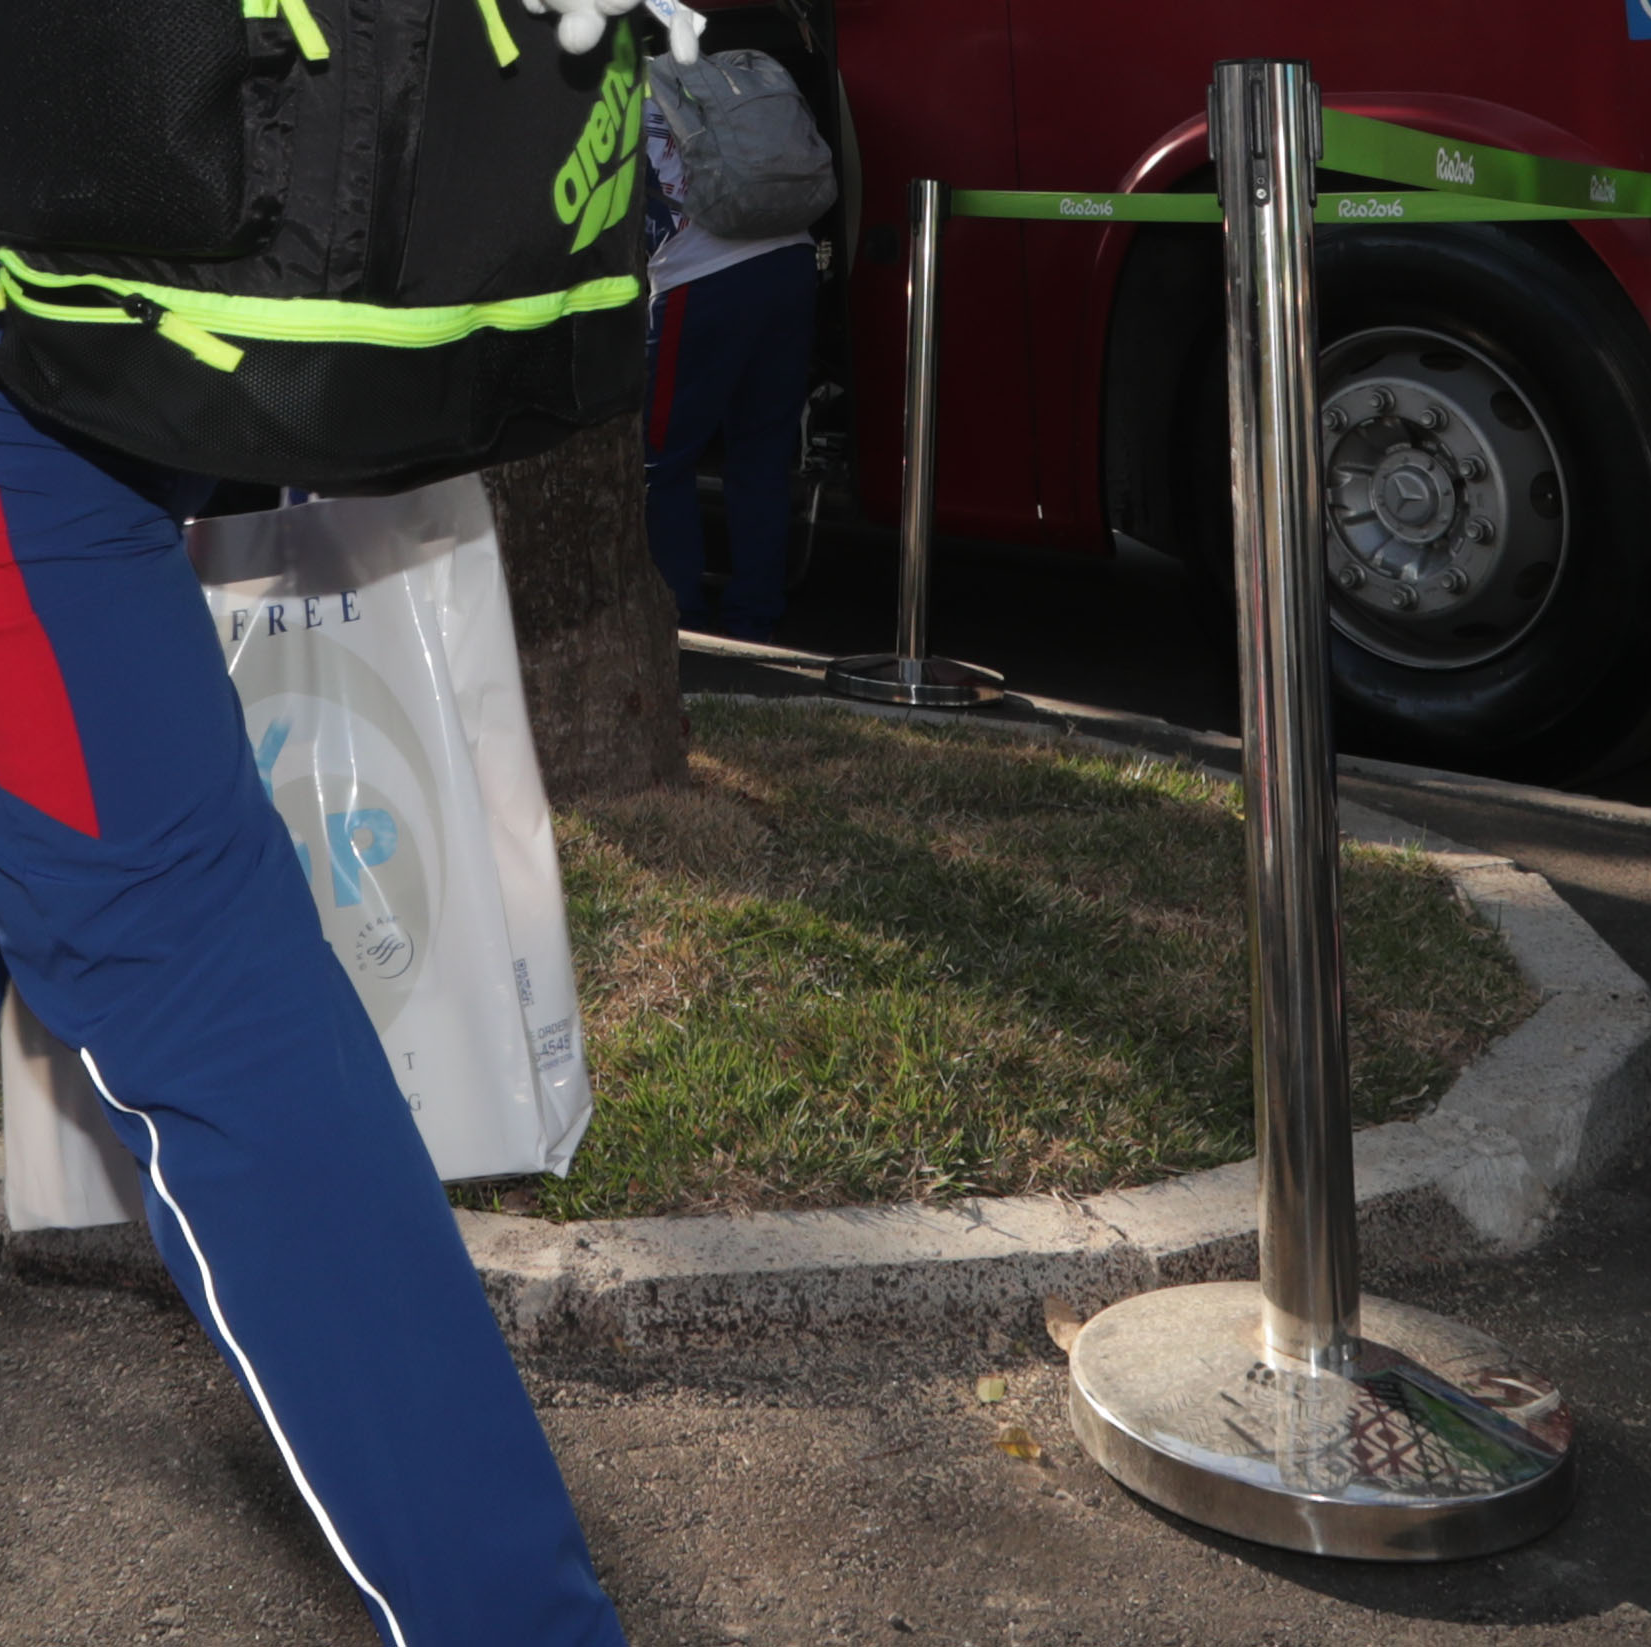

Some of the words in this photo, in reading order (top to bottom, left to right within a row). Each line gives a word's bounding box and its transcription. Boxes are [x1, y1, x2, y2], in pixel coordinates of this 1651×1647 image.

[1436, 147, 1475, 185] Rio2016
[1059, 197, 1113, 217] Rio2016
[1338, 197, 1404, 218] Rio2016
[230, 589, 362, 643] FREE
